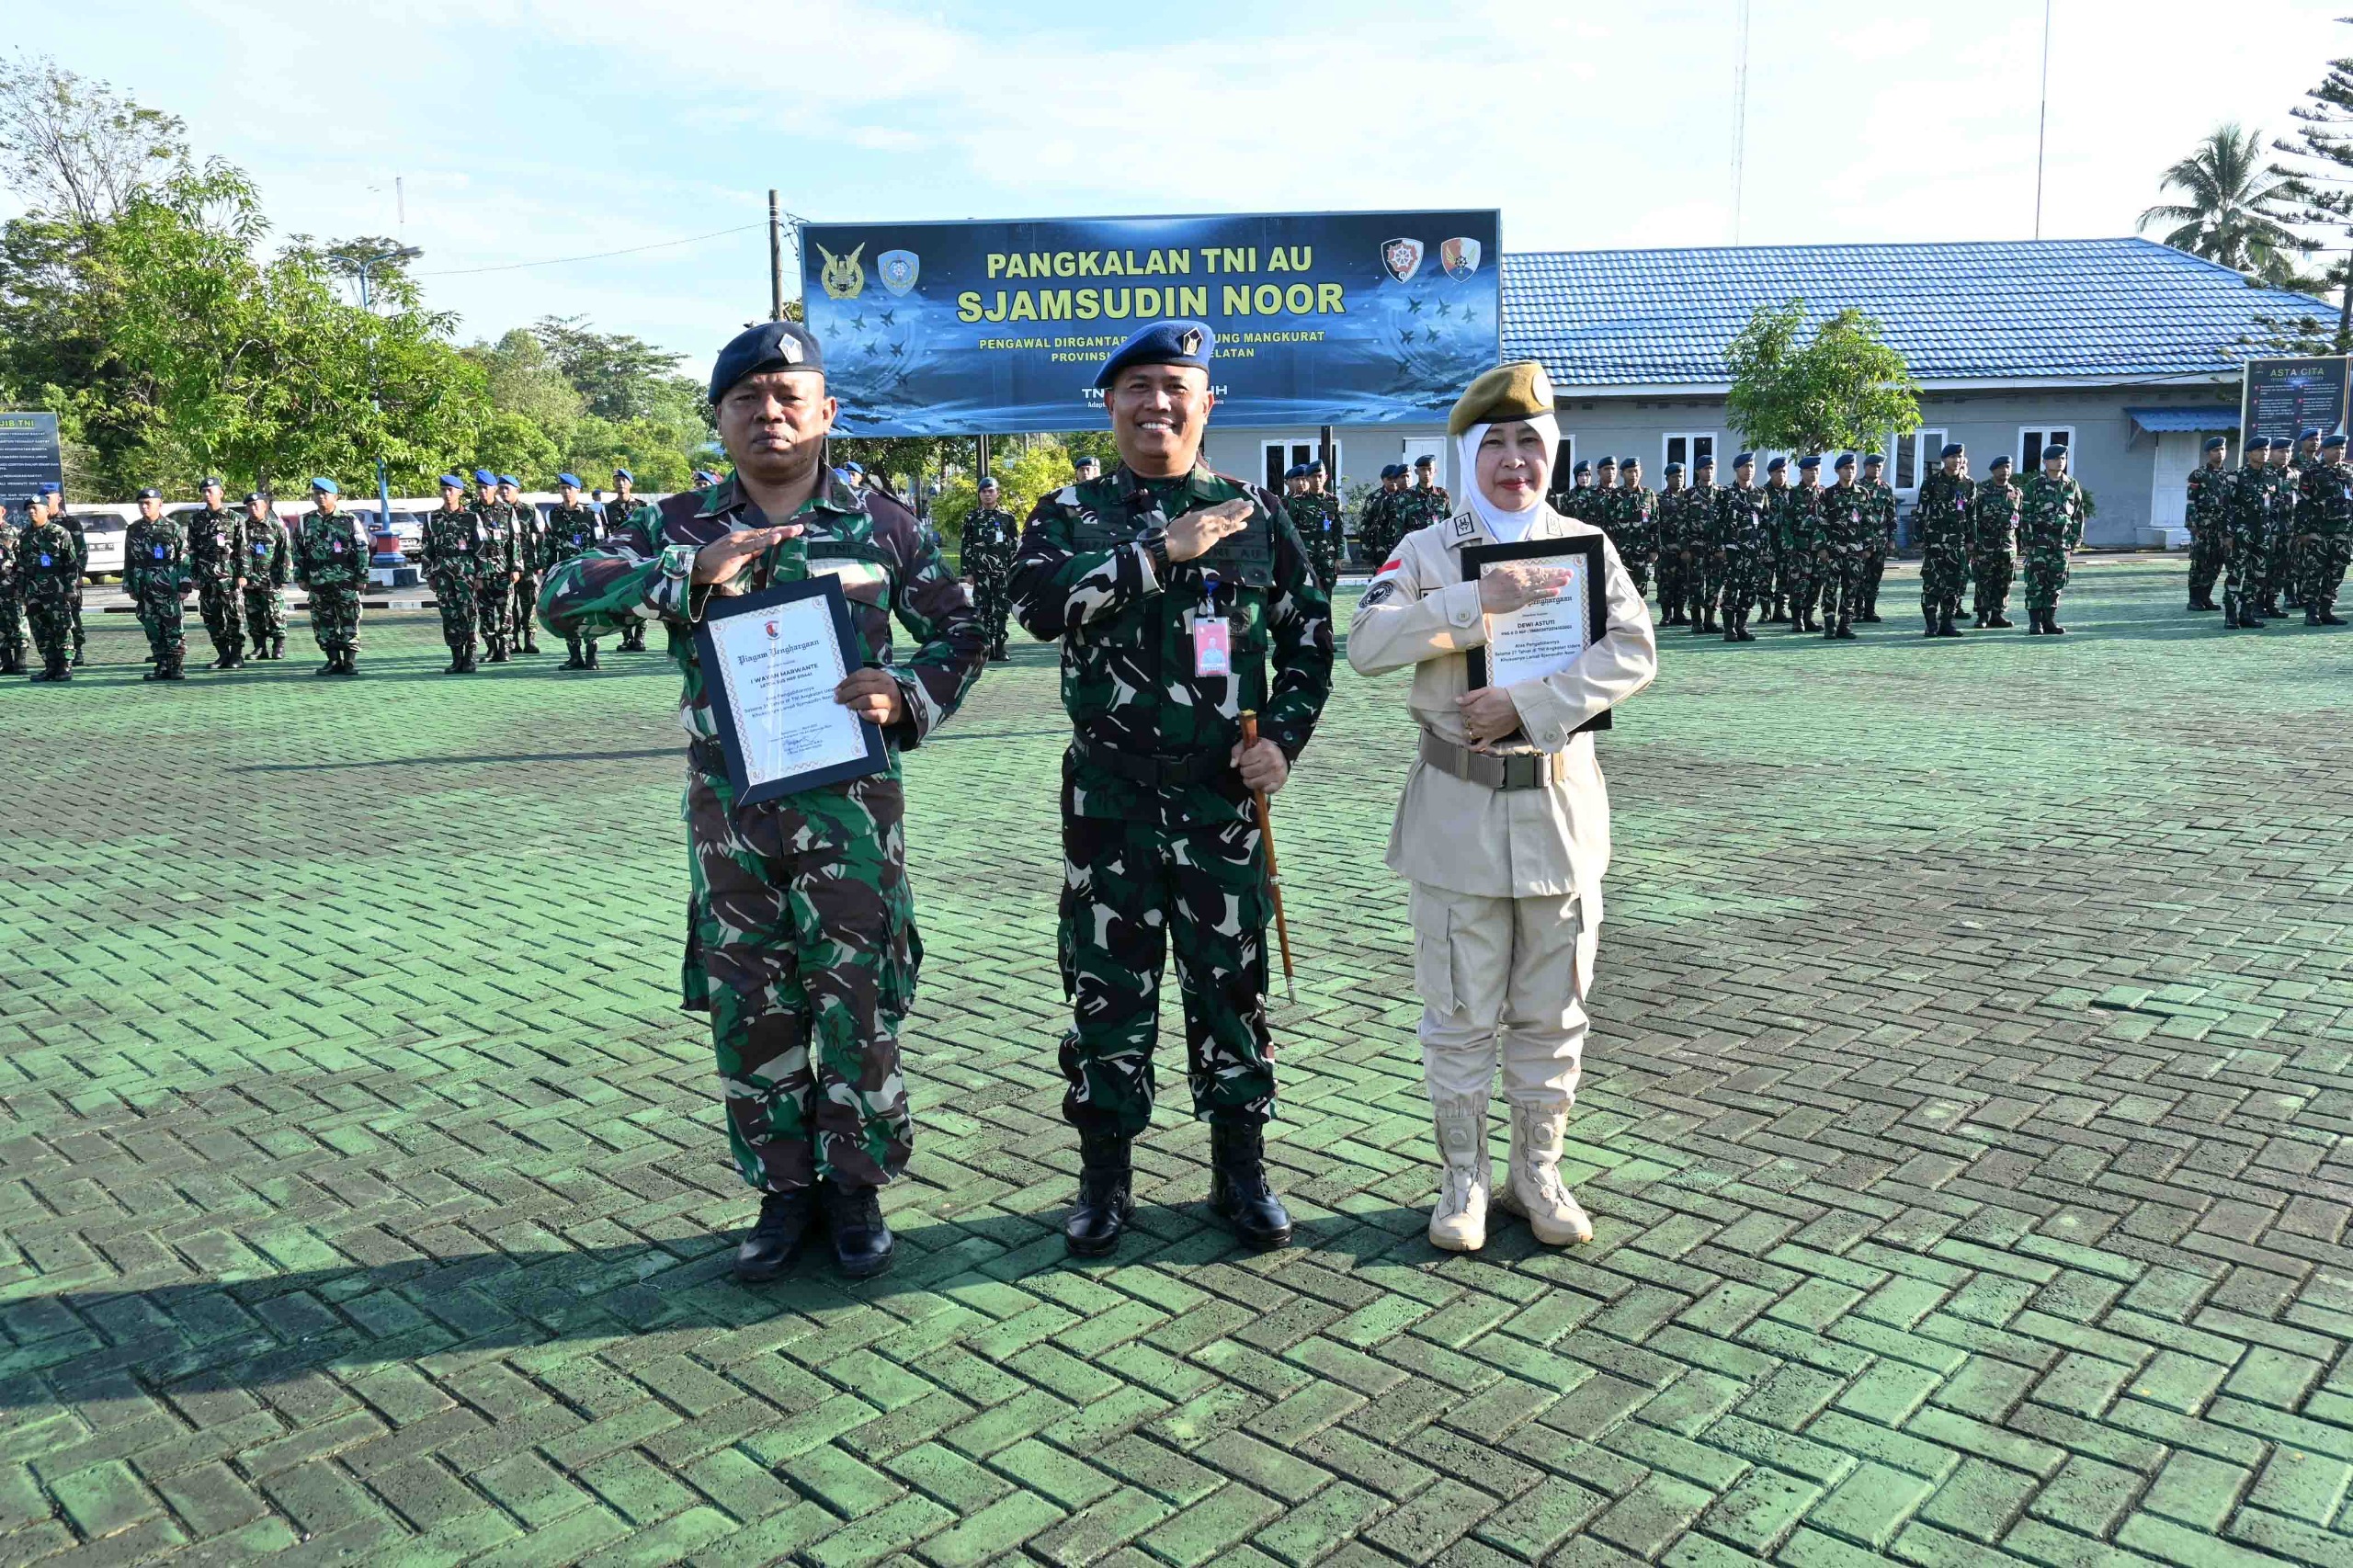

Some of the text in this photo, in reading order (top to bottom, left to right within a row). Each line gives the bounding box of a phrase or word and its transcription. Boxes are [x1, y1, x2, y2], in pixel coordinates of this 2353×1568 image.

[987, 245, 1313, 279] PANGKALAN TNI AU
[957, 282, 1347, 324] SJAMSUDIN NOOR
[979, 337, 1051, 350] PENGAWAL
[1244, 330, 1325, 344] MANGKURAT
[2270, 369, 2297, 377] ASTA
[2301, 367, 2325, 376] CITA
[1081, 388, 1105, 399] TN
[737, 653, 768, 665] Piagam
